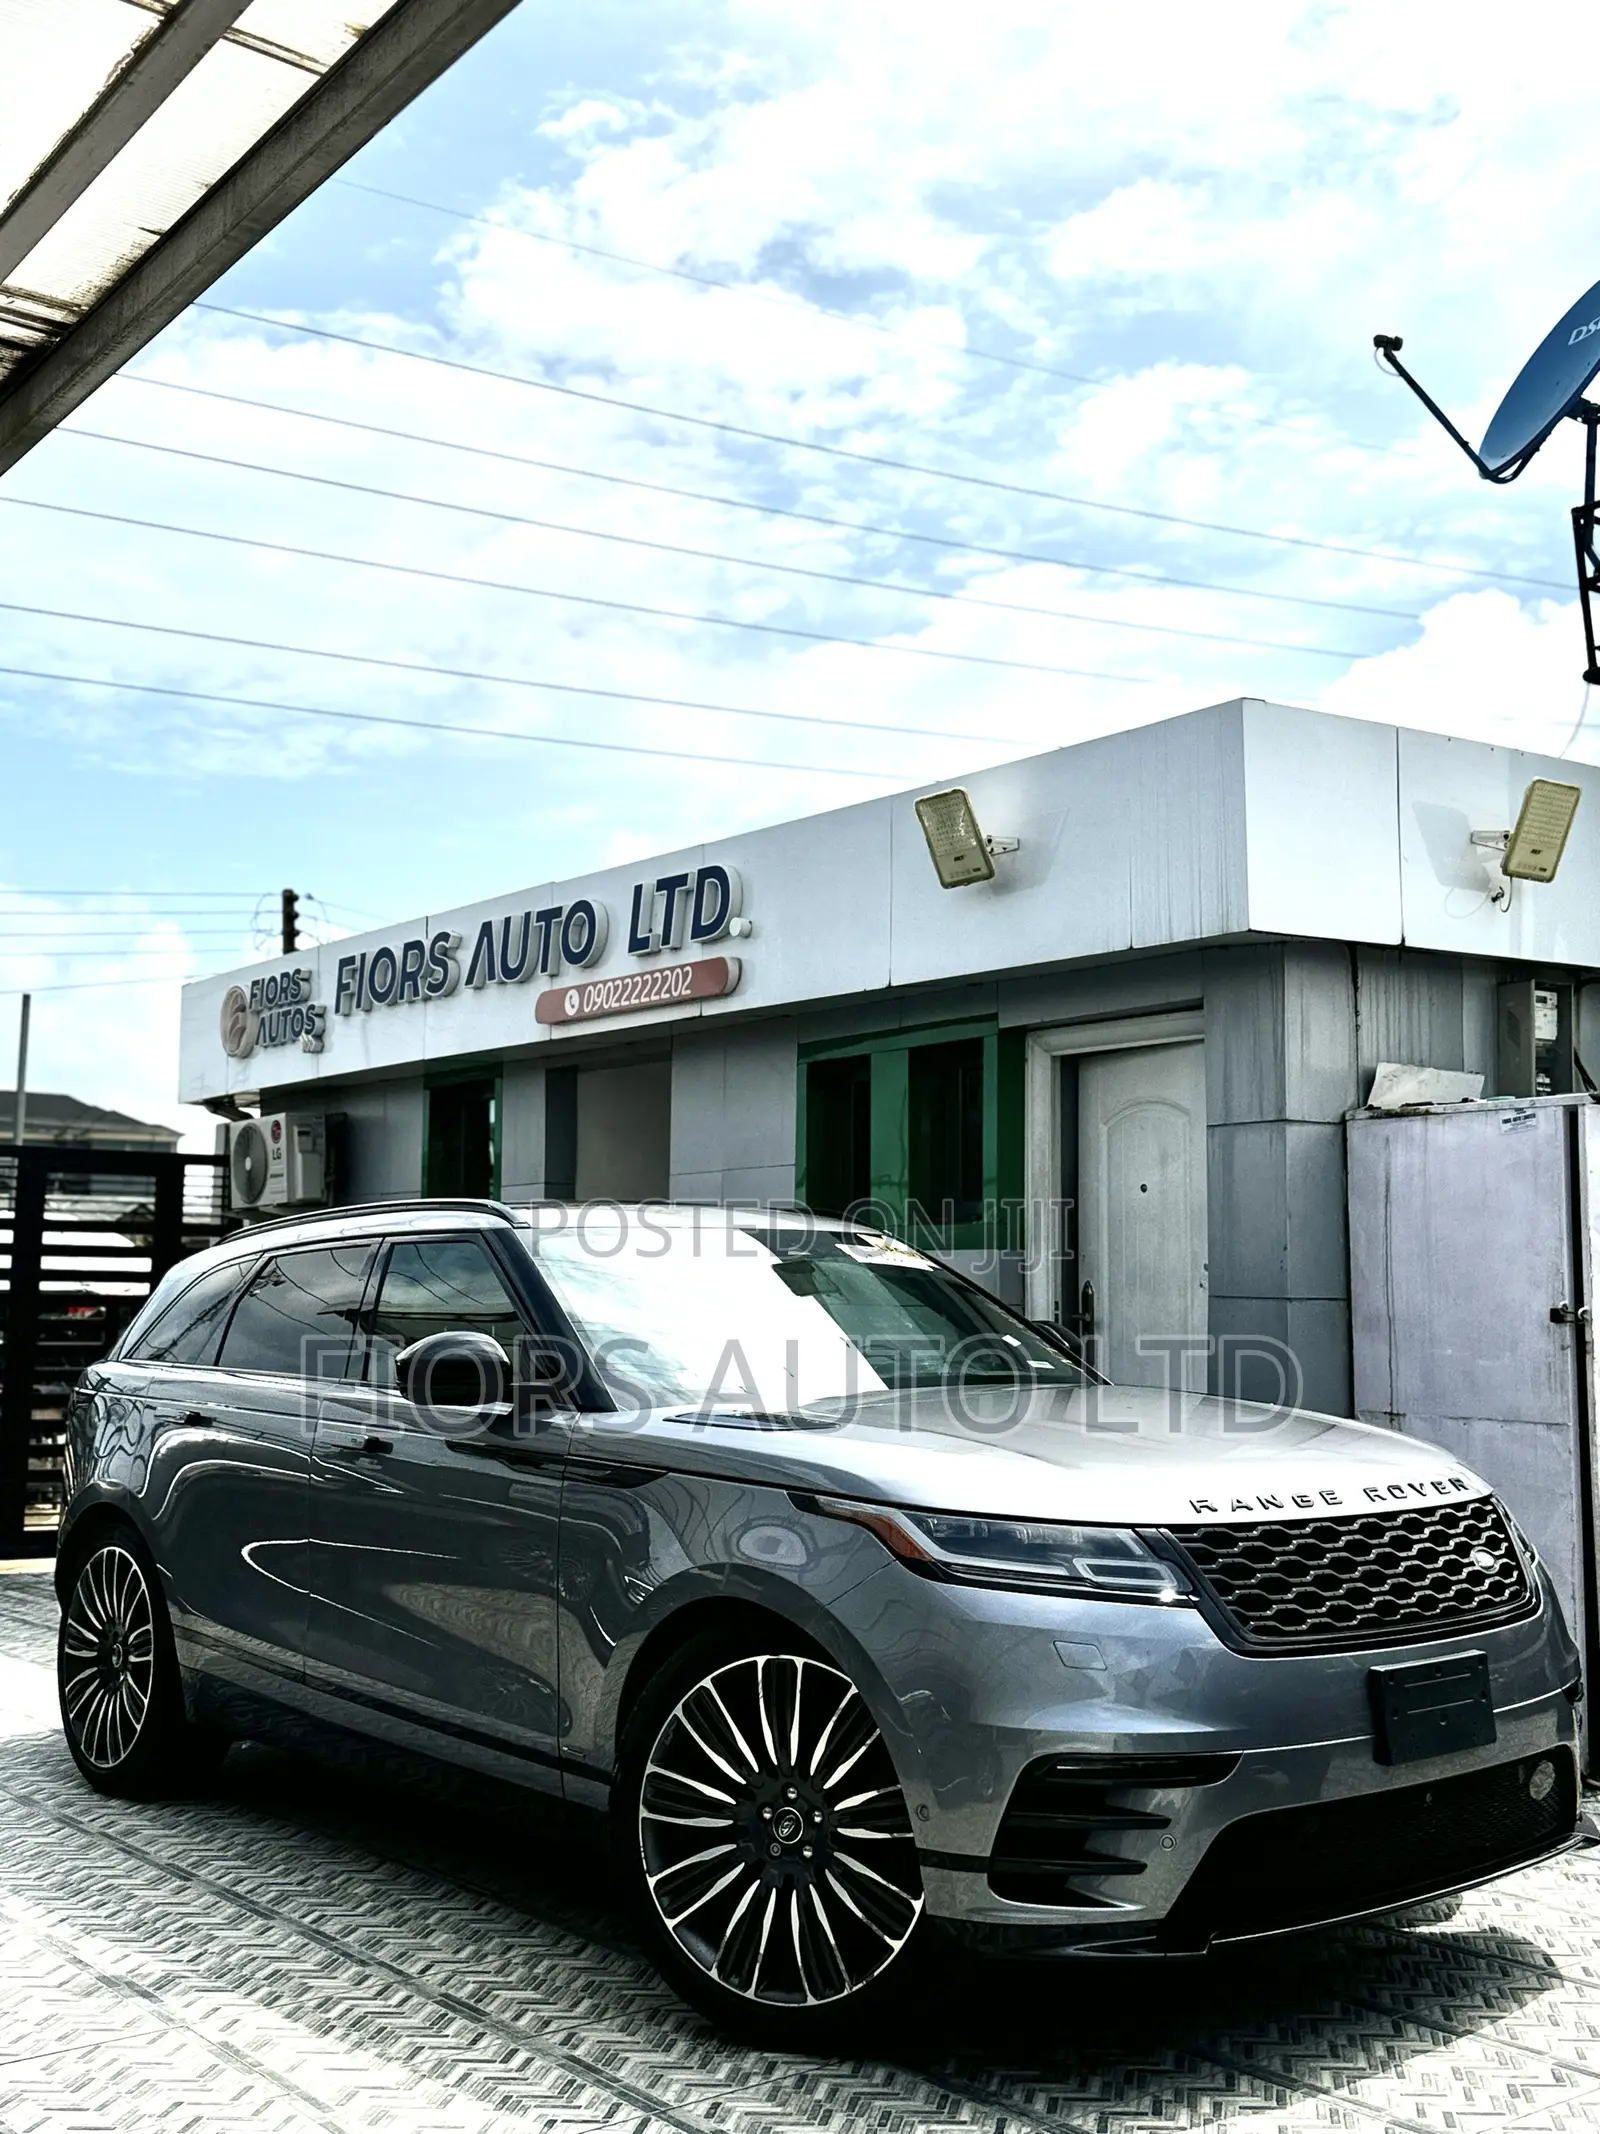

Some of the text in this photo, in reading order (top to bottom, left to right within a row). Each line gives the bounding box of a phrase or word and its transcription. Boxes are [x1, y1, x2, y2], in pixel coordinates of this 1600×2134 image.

[333, 864, 751, 1016] FIORS AUTO LTD.
[249, 968, 305, 1011] FIORS
[583, 966, 693, 1013] 09022222202
[255, 1004, 320, 1046] AUTOS
[272, 1147, 282, 1161] LG
[1189, 1477, 1469, 1514] RANGE ROVER
